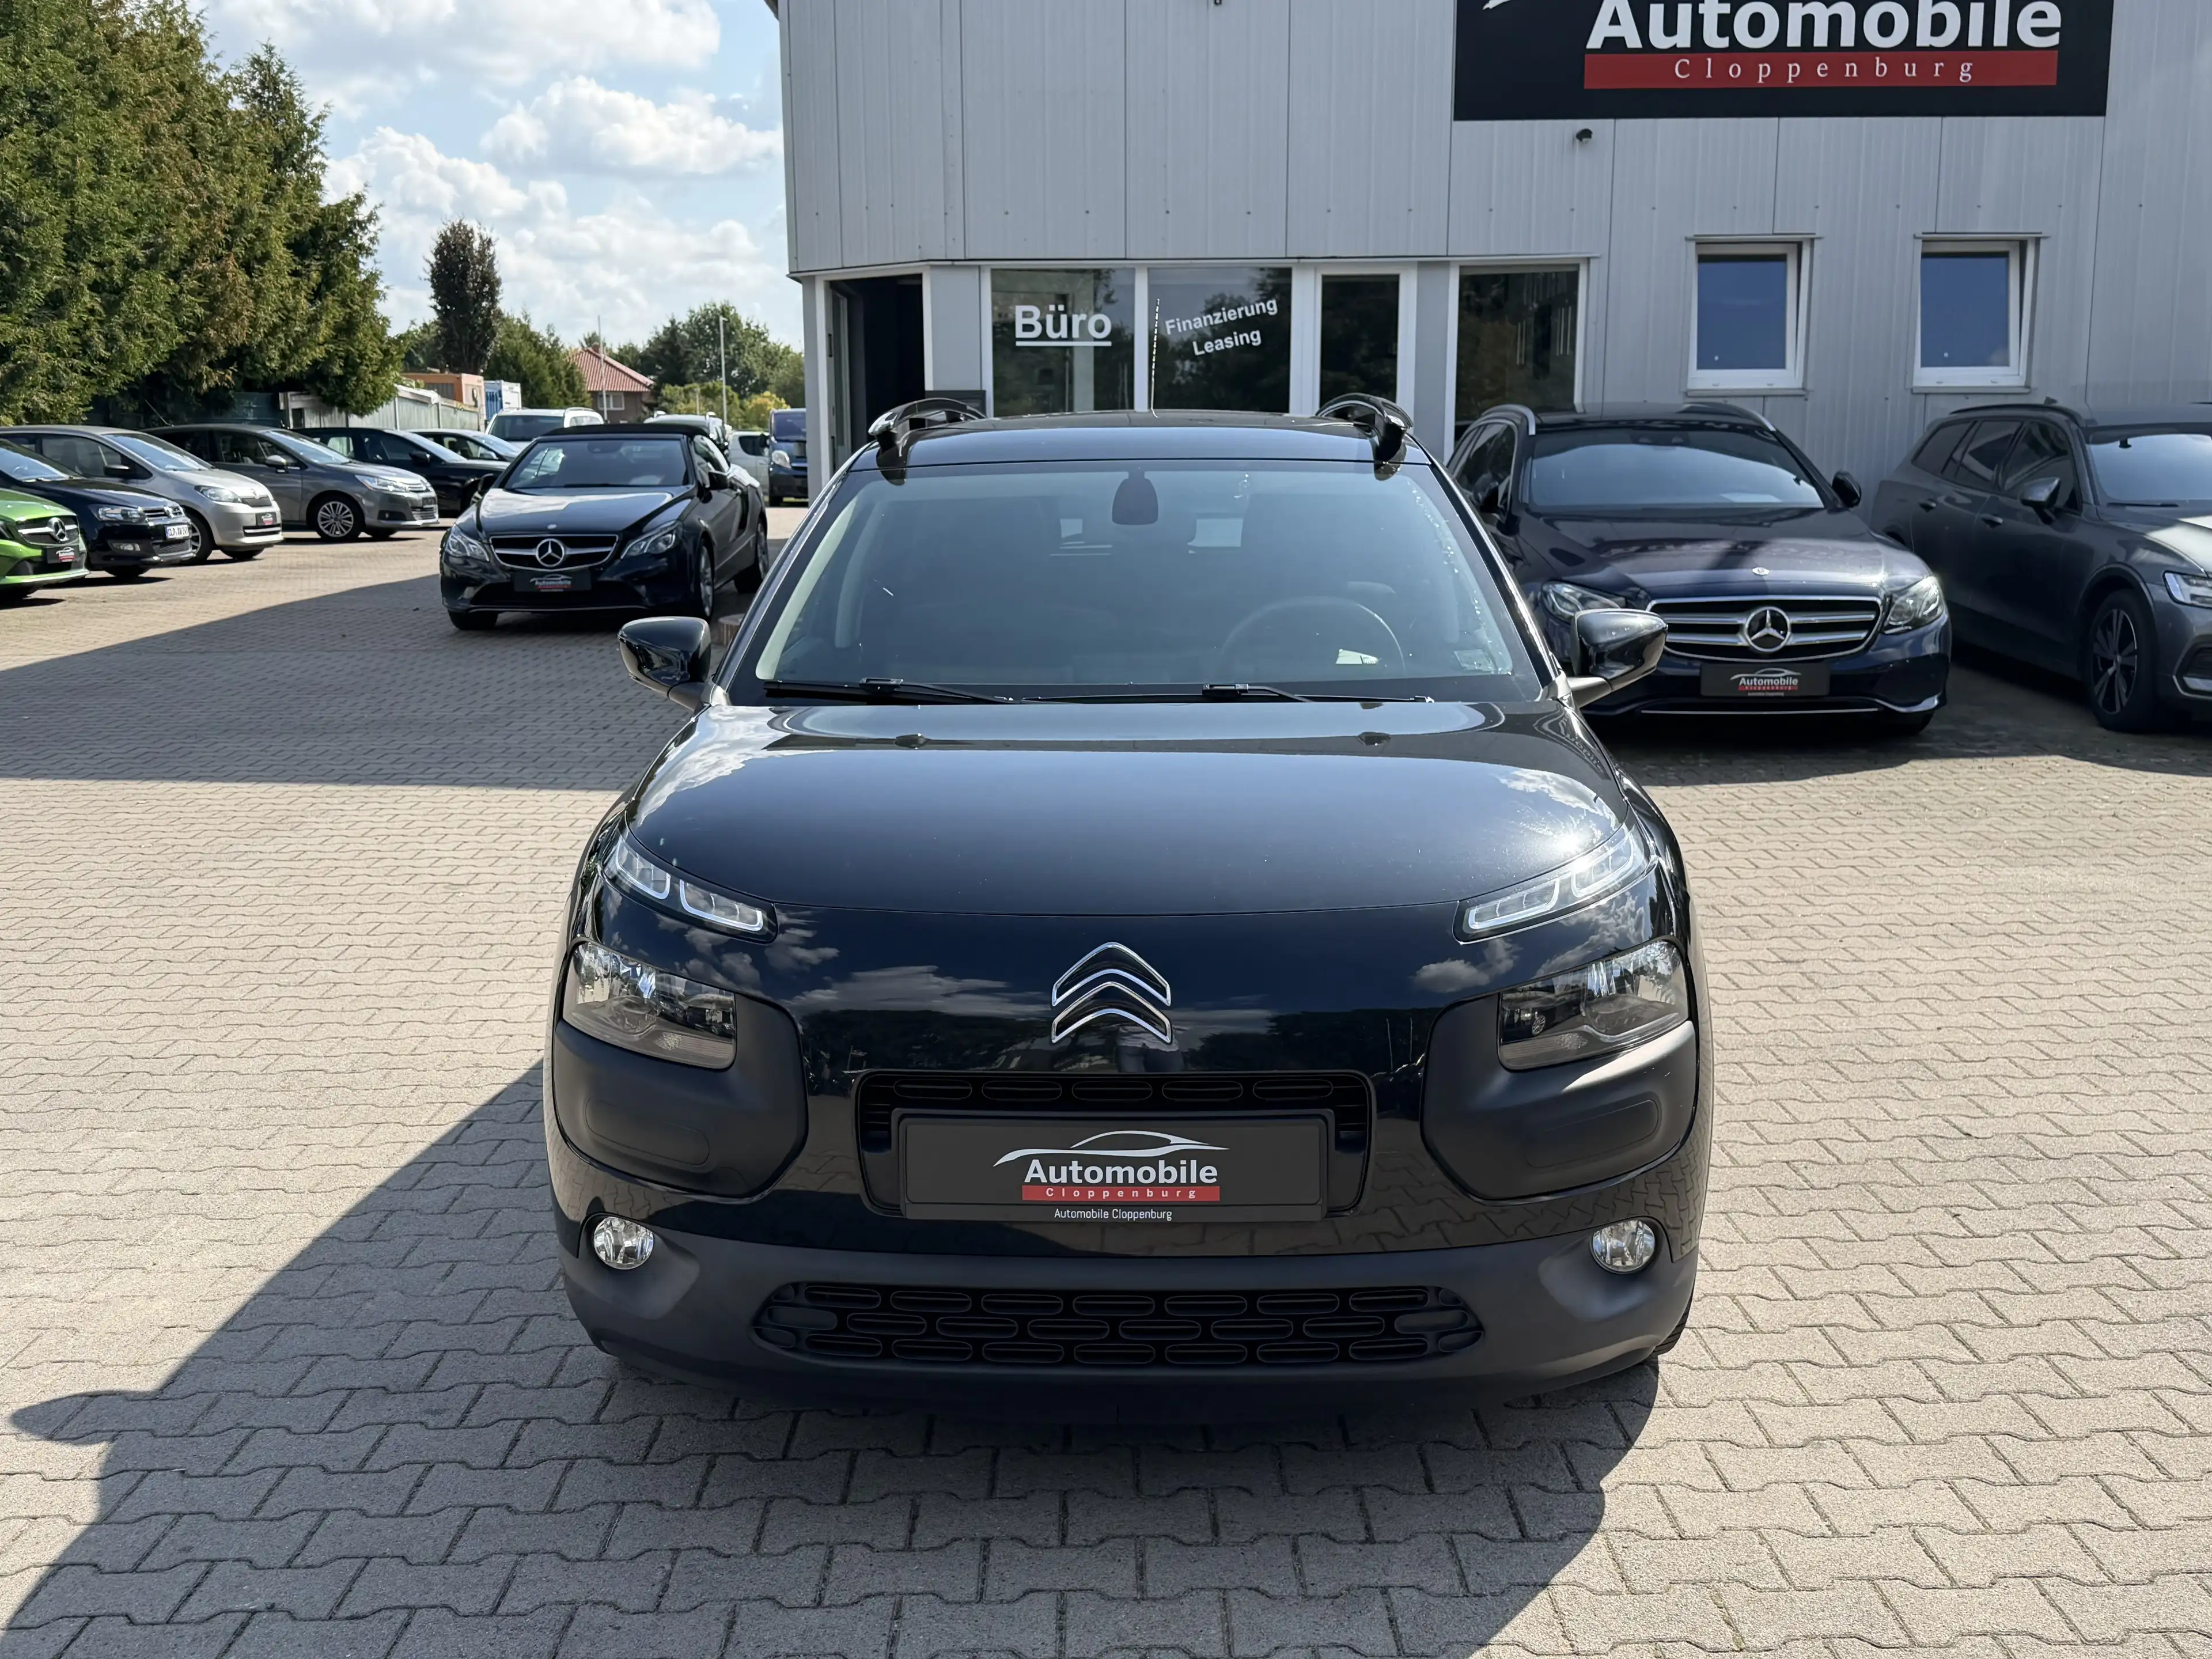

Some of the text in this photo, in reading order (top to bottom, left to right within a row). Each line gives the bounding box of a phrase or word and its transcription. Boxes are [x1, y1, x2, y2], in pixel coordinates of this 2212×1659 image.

[1586, 0, 2060, 49] Automobile
[1674, 56, 1972, 84] Cloppenburg
[1015, 304, 1111, 339] Büro
[1165, 298, 1278, 335] Finanzierung
[1192, 327, 1262, 356] Leasing
[1739, 677, 1798, 685] Automobile
[1024, 1159, 1217, 1183] Automobile
[1045, 1187, 1196, 1199] Cloppenburg
[1054, 1208, 1172, 1221] Automobile Cloppenburg
